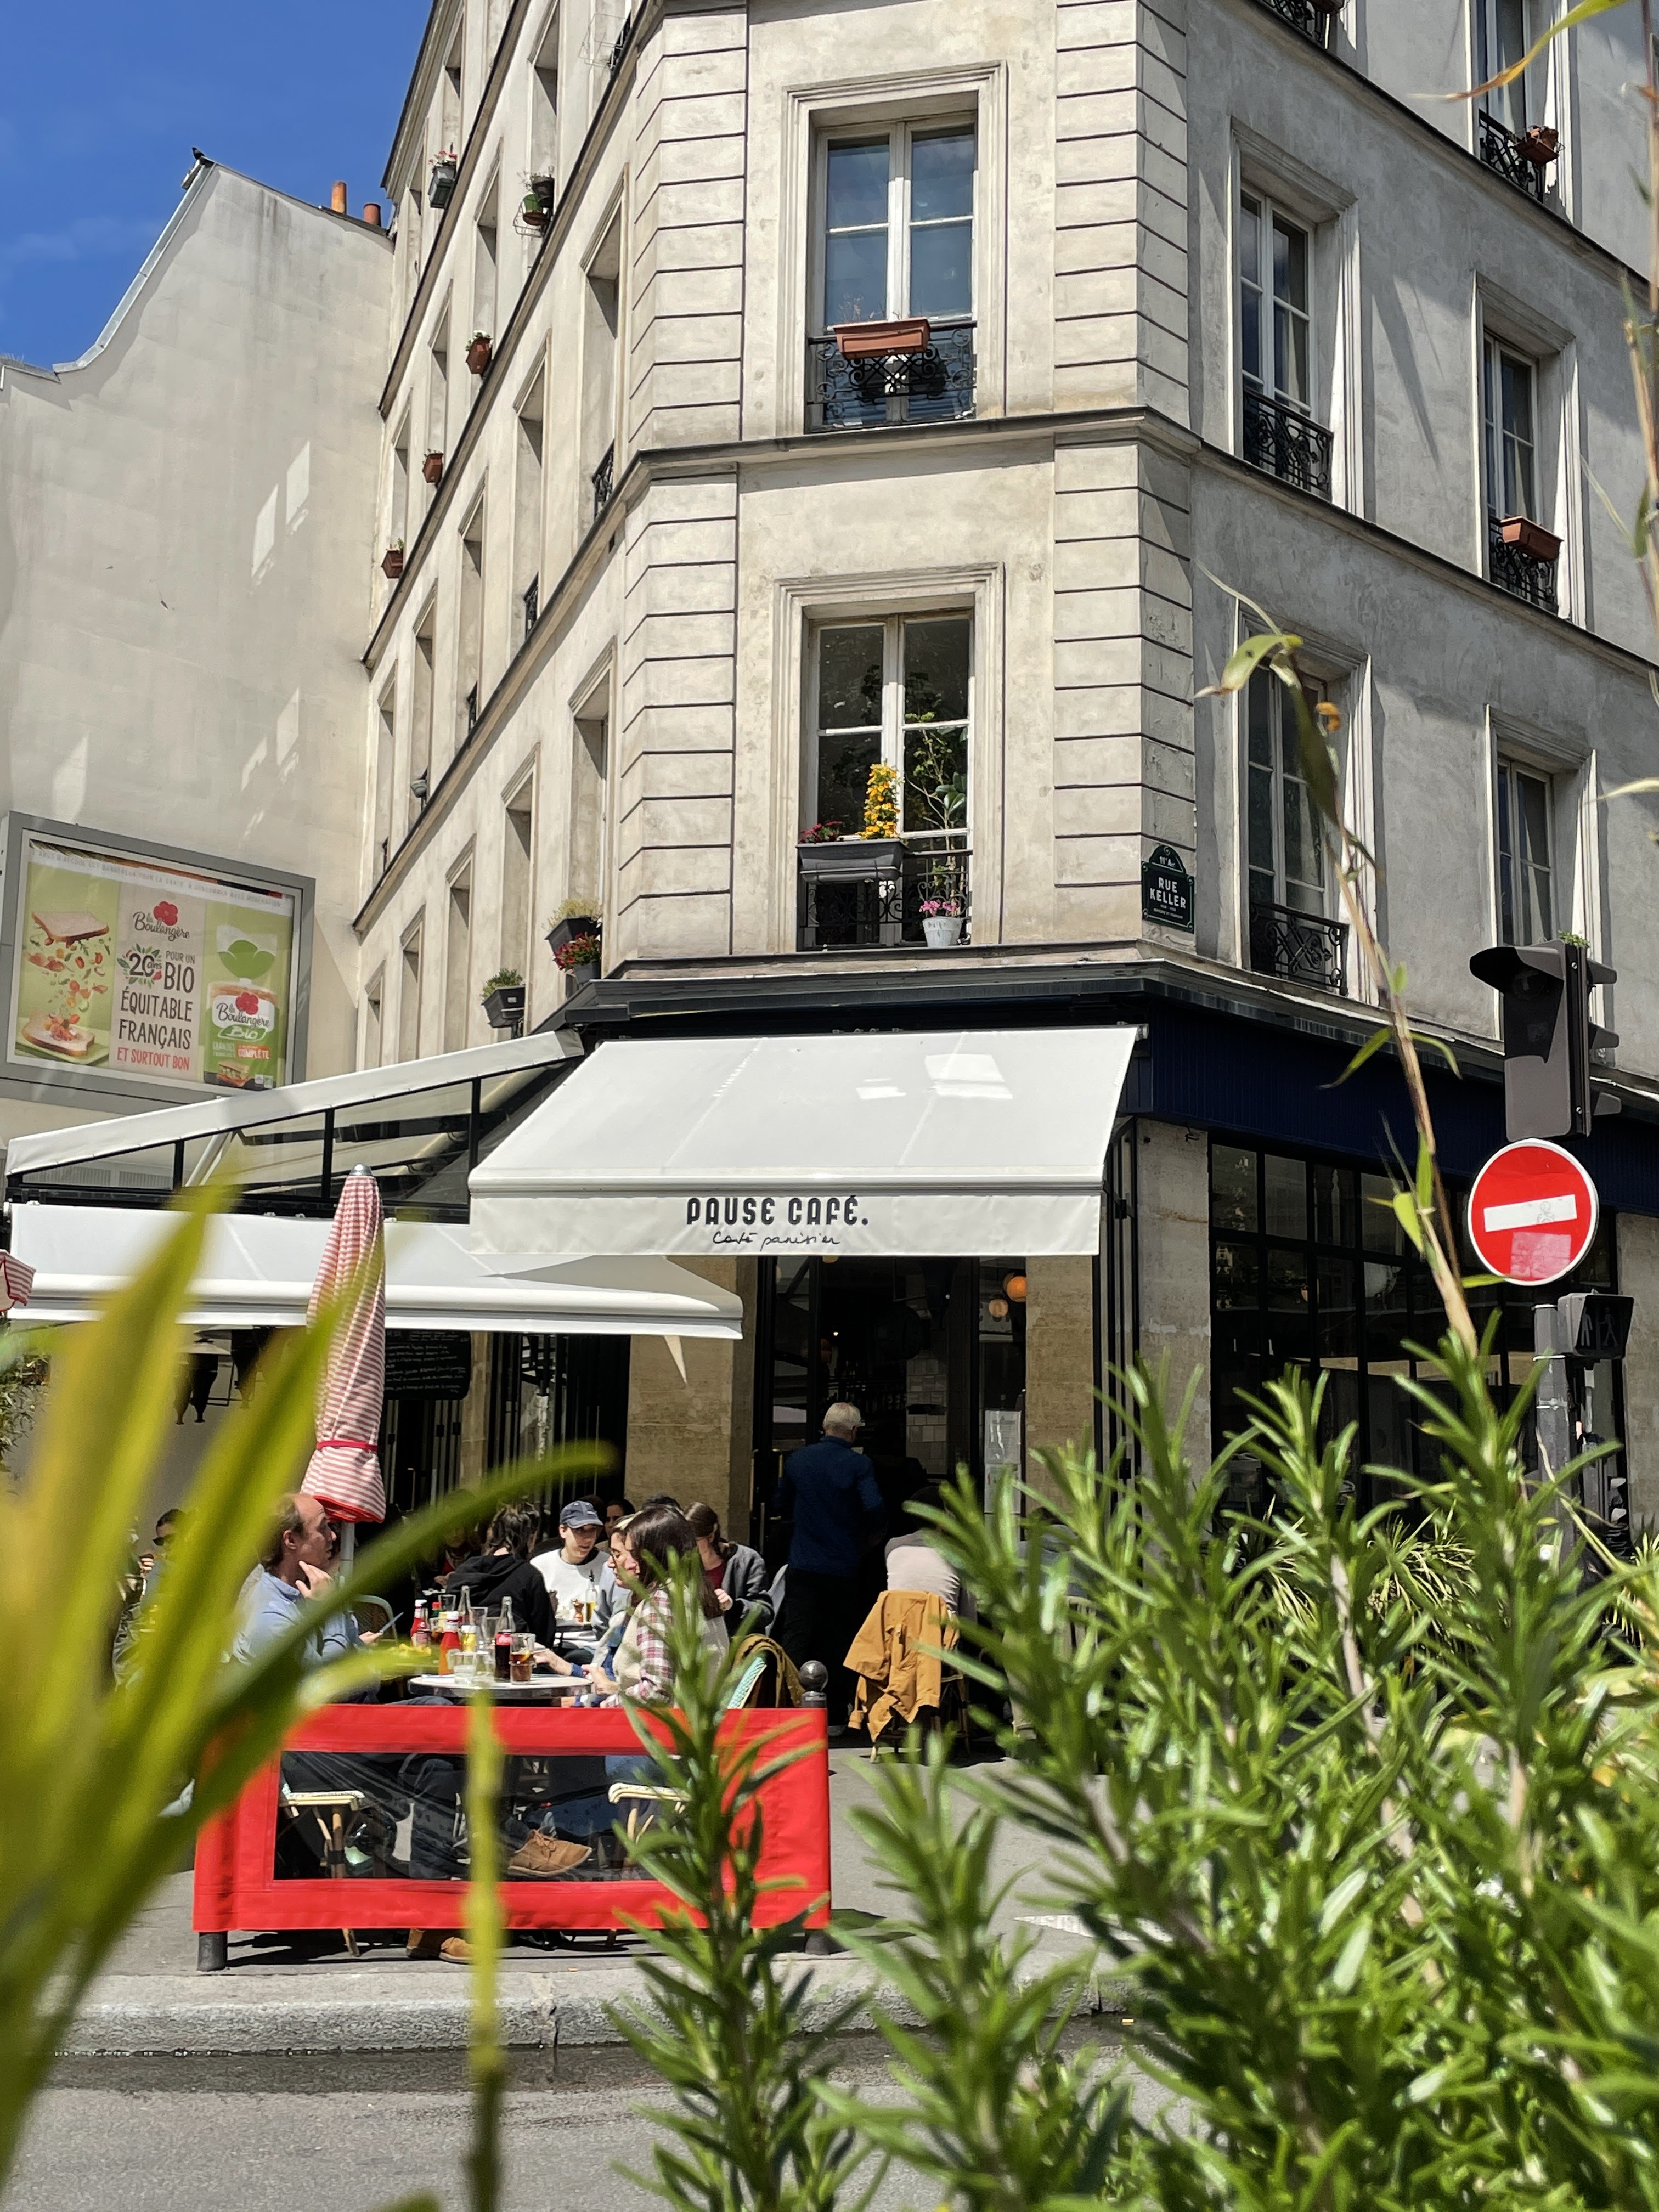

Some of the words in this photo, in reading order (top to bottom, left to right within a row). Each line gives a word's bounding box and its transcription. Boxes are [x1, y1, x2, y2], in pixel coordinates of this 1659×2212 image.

[1150, 888, 1186, 909] KELLER
[1159, 877, 1177, 893] RUE
[132, 911, 190, 942] Boulangère
[166, 950, 183, 963] POUR
[185, 955, 195, 965] UN
[164, 962, 195, 994] BIO
[120, 986, 193, 1022] ÉQUITABLE
[216, 1002, 270, 1031] Boulangère
[119, 1018, 191, 1050] FRANÇAIS
[117, 1047, 129, 1062] ET
[131, 1049, 171, 1068] SURTOUT
[172, 1056, 190, 1071] BON
[687, 1197, 775, 1226] PAUSE
